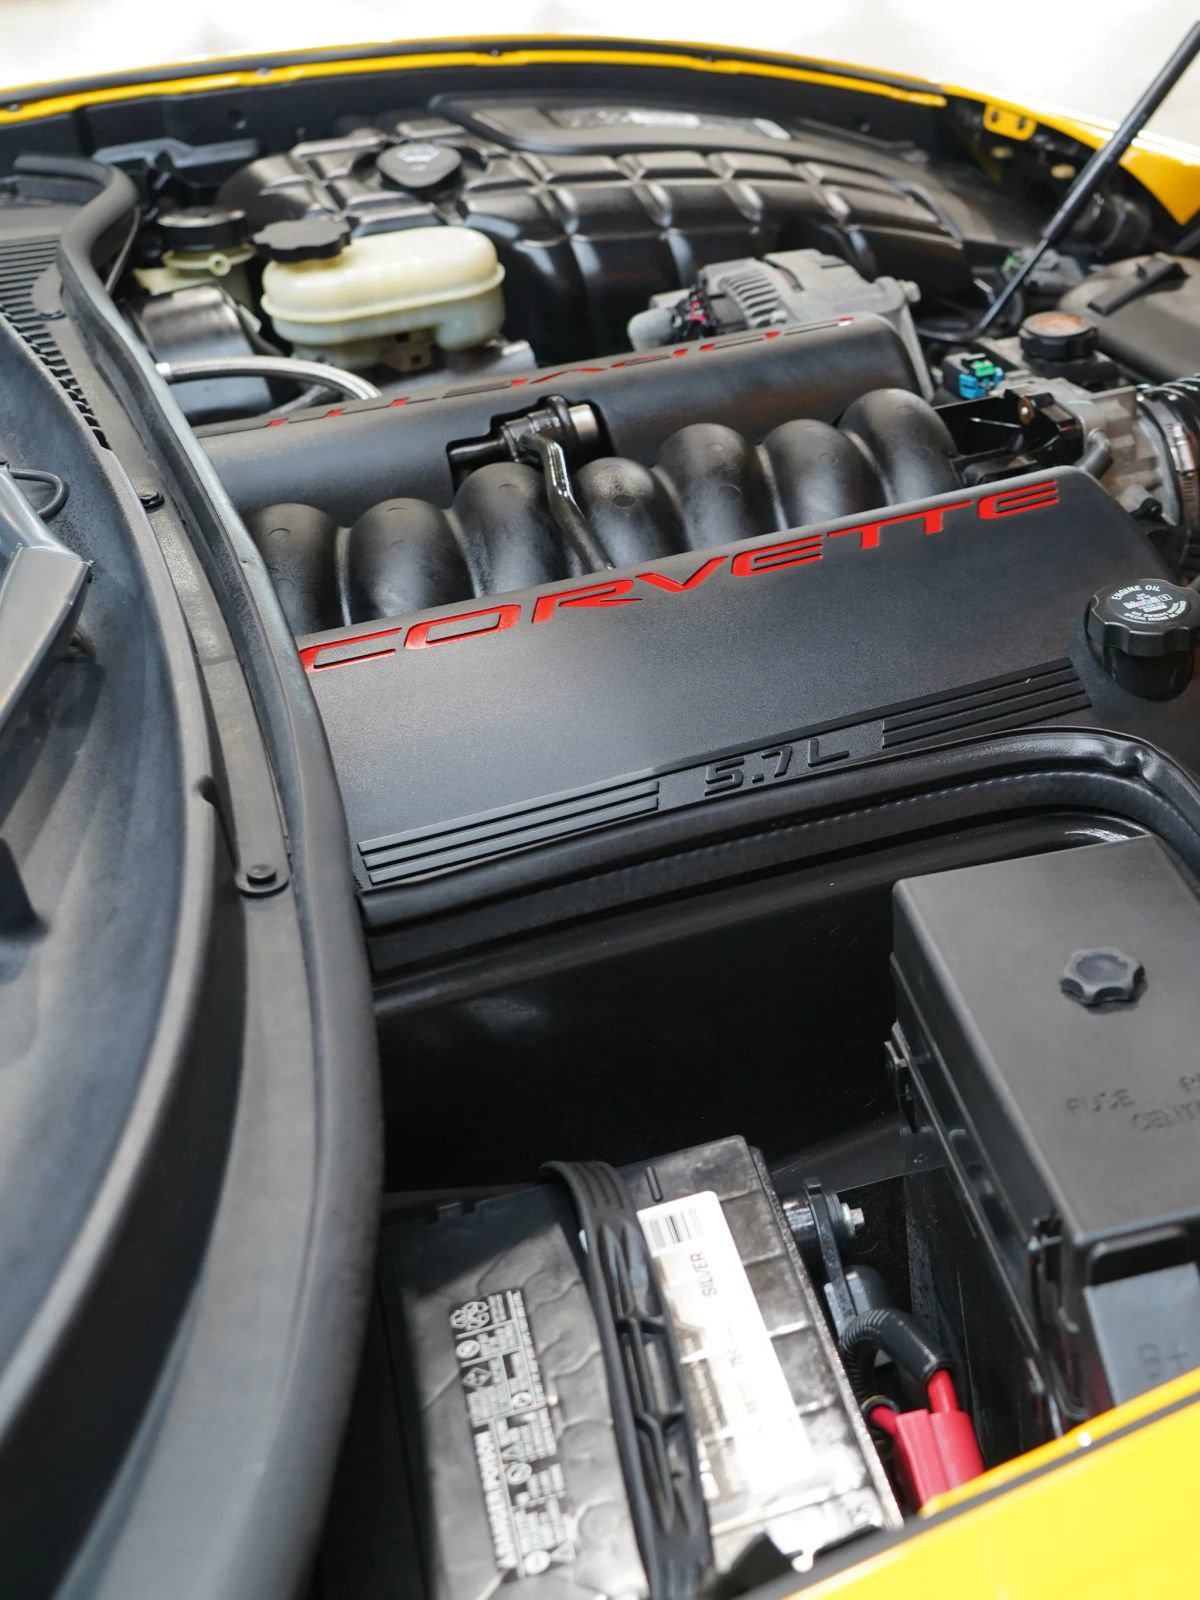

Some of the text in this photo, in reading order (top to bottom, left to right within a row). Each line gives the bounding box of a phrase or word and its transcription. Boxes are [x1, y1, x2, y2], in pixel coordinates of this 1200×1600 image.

[300, 479, 1058, 674] CORVETTE
[1110, 585, 1142, 600] ENGINE
[689, 1252, 718, 1298] SILVER
